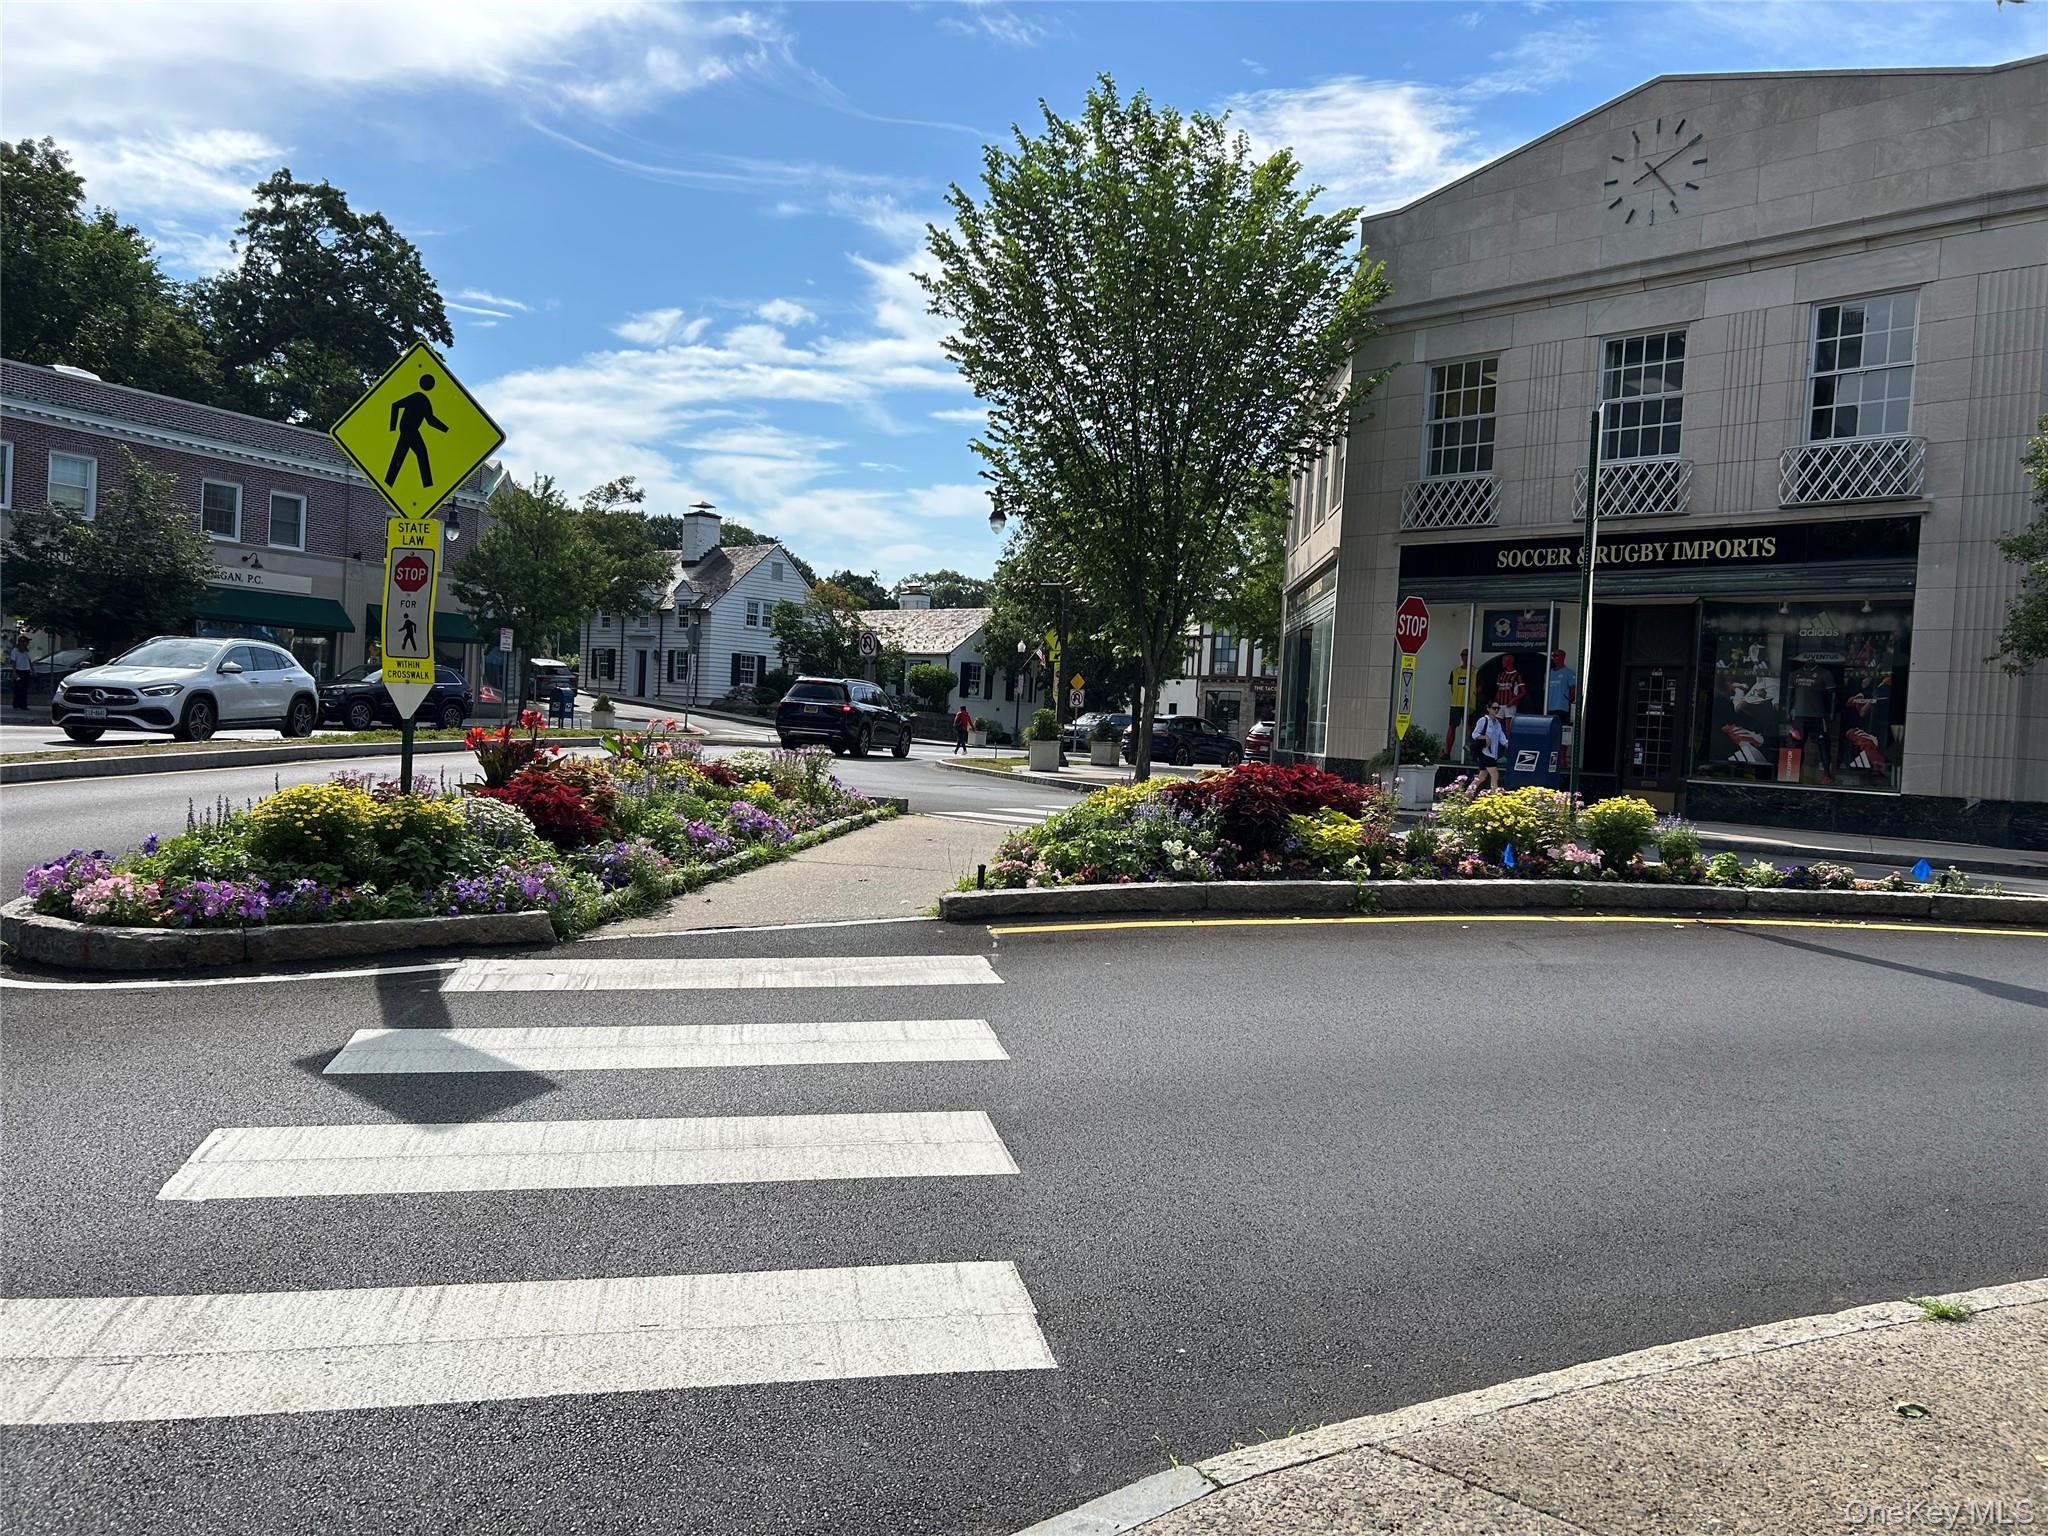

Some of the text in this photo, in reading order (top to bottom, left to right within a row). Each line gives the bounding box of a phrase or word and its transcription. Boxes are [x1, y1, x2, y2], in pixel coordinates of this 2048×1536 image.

[398, 523, 430, 534] STATE
[402, 535, 425, 546] LAW
[1496, 548, 1573, 568] SOCCER
[1594, 543, 1669, 564] RUGBY
[1672, 536, 1776, 560] IMPORTS
[247, 574, 264, 585] P.C.
[396, 567, 426, 581] STOP
[400, 600, 417, 609] FOR
[1397, 614, 1428, 637] STOP
[1799, 627, 1839, 637] adidas
[396, 660, 420, 669] WITHIN
[387, 670, 430, 680] CROSSWALK
